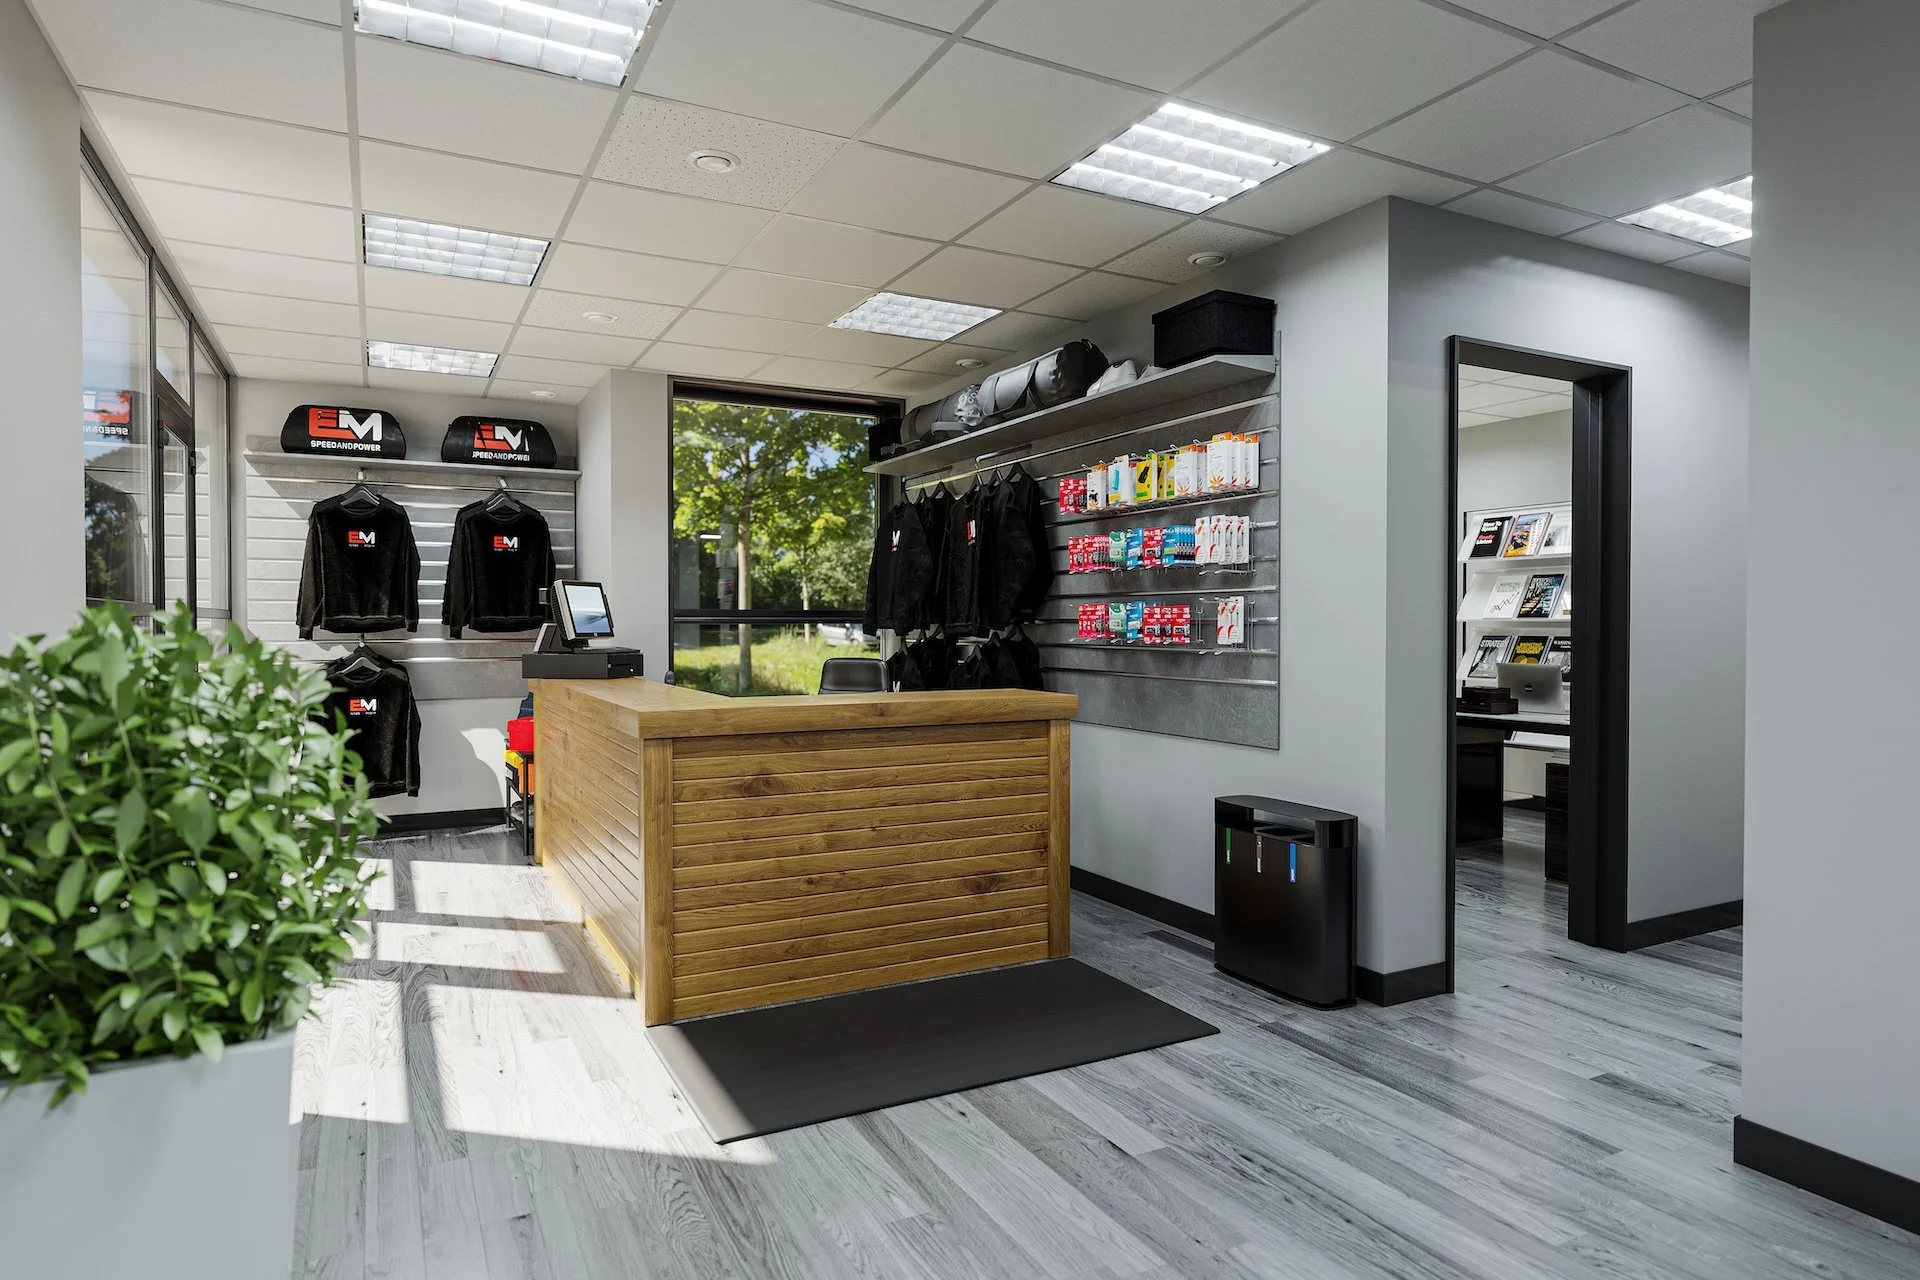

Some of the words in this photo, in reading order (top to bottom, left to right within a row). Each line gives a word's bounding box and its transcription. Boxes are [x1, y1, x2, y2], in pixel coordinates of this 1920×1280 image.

[308, 407, 383, 441] EM
[310, 440, 381, 451] SPEEDANDPOWER
[349, 531, 375, 544] EM
[494, 536, 518, 549] EM
[350, 699, 377, 711] EM
